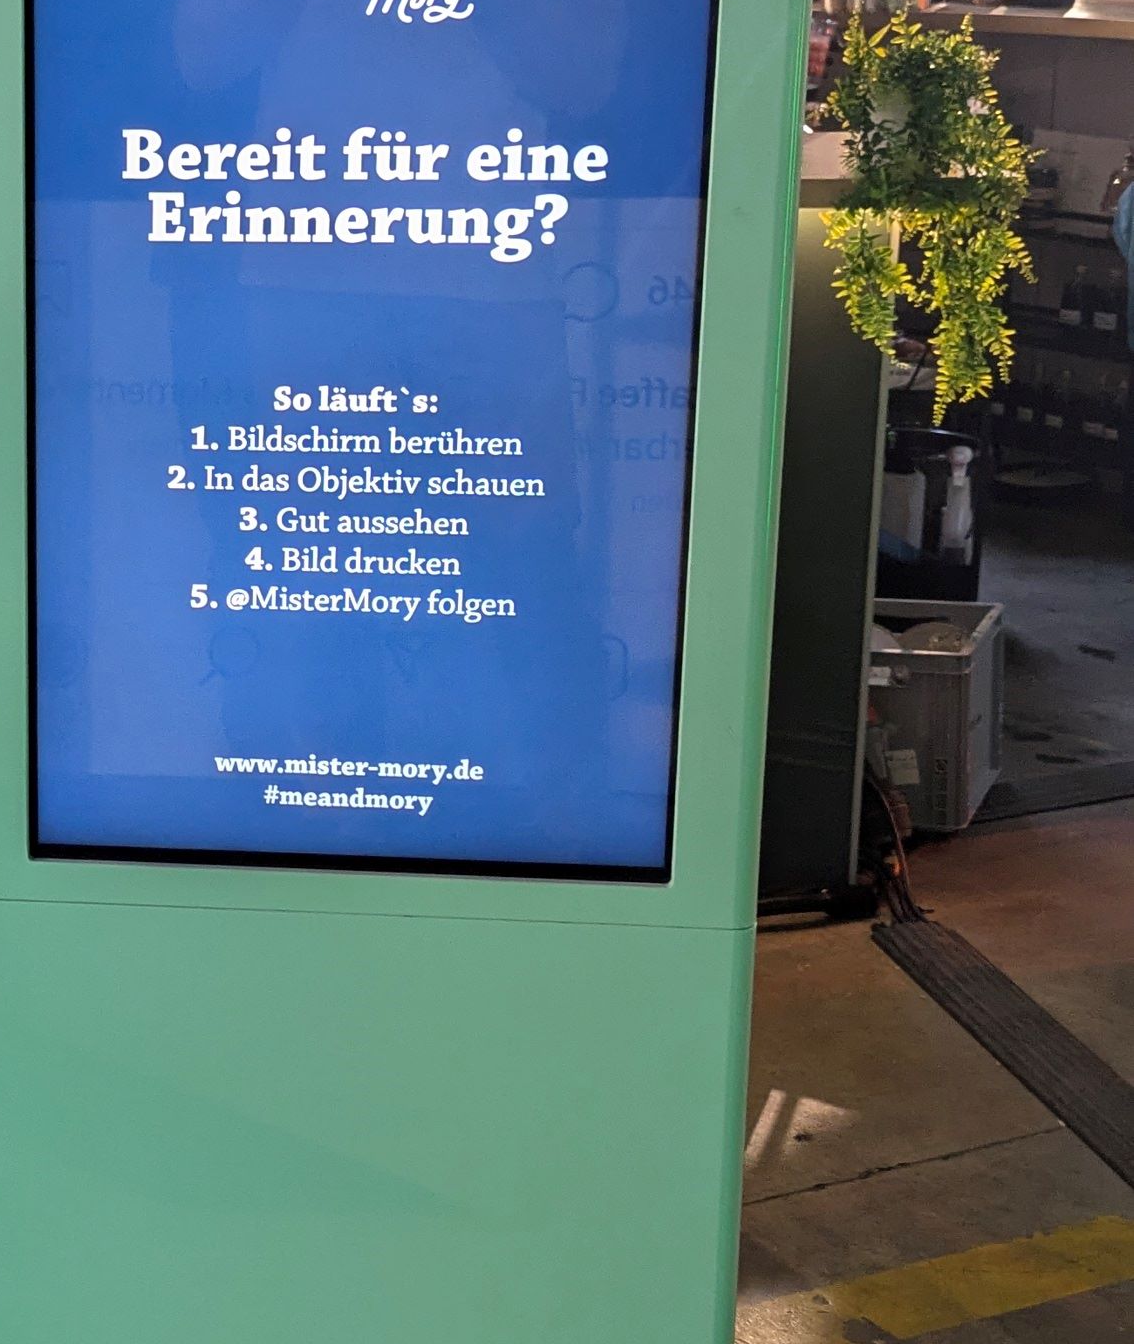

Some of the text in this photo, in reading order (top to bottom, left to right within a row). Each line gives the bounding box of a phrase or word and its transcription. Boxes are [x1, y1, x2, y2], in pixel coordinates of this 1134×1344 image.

[122, 127, 609, 181] Bereit für eine
[148, 191, 569, 263] Erinnerung?
[274, 386, 312, 412] So
[191, 425, 523, 456] 1. Bildschirm berühren
[168, 464, 546, 501] 2. In das Objektiv schauen
[239, 507, 469, 536] 3. Gut aussehen
[244, 545, 461, 576] 4. Bild drucken
[190, 584, 516, 624] 5. @MisterMory folgen
[214, 754, 484, 786] www.mister-mory.de
[264, 785, 434, 816] #meandmory
